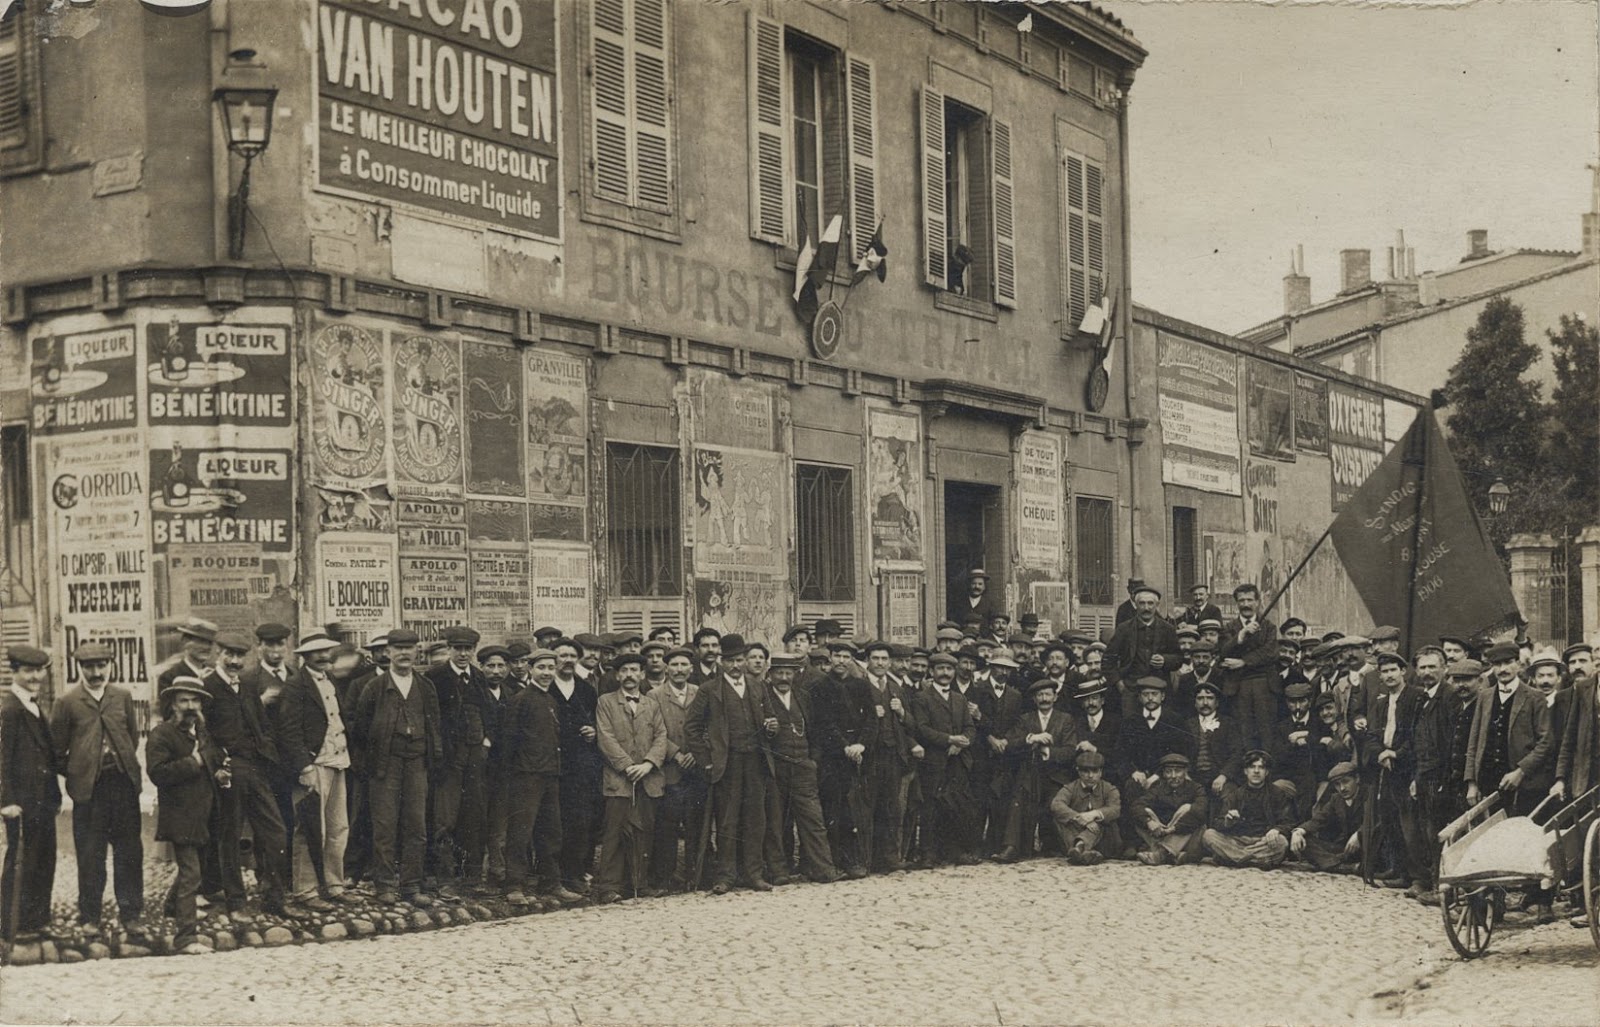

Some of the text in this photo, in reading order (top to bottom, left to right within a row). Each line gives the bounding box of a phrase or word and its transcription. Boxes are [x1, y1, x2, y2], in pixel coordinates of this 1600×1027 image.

[319, 5, 552, 143] VAN HOUTEN
[330, 102, 549, 184] LE MEILLEUR CHOCOLAT
[339, 146, 542, 219] à Consommer Liquide
[586, 235, 782, 337] BOURSE
[70, 336, 129, 359] LIQUEUR
[528, 356, 582, 379] GRANVILLE
[33, 395, 135, 429] BÉNÉDICTINE
[321, 377, 380, 428] SINGER
[402, 387, 456, 435] SINGER
[1035, 448, 1054, 461] TOUT
[52, 471, 143, 509] CORRIDA
[64, 515, 71, 532] 7
[133, 510, 140, 527] 7
[419, 530, 461, 546] APOLLO
[116, 549, 146, 574] VALLE
[192, 557, 260, 569] ROQUES
[410, 560, 457, 571] APOLLO
[249, 576, 270, 594] URE
[337, 580, 390, 608] BOUCHER
[536, 586, 551, 598] FIN
[560, 587, 587, 599] SAISON
[67, 580, 142, 614] NEGRETE
[190, 588, 249, 607] MENSONGES
[403, 597, 466, 611] GRAVELYN
[335, 608, 383, 618] DE MEUDON
[65, 625, 149, 684] BBITA
